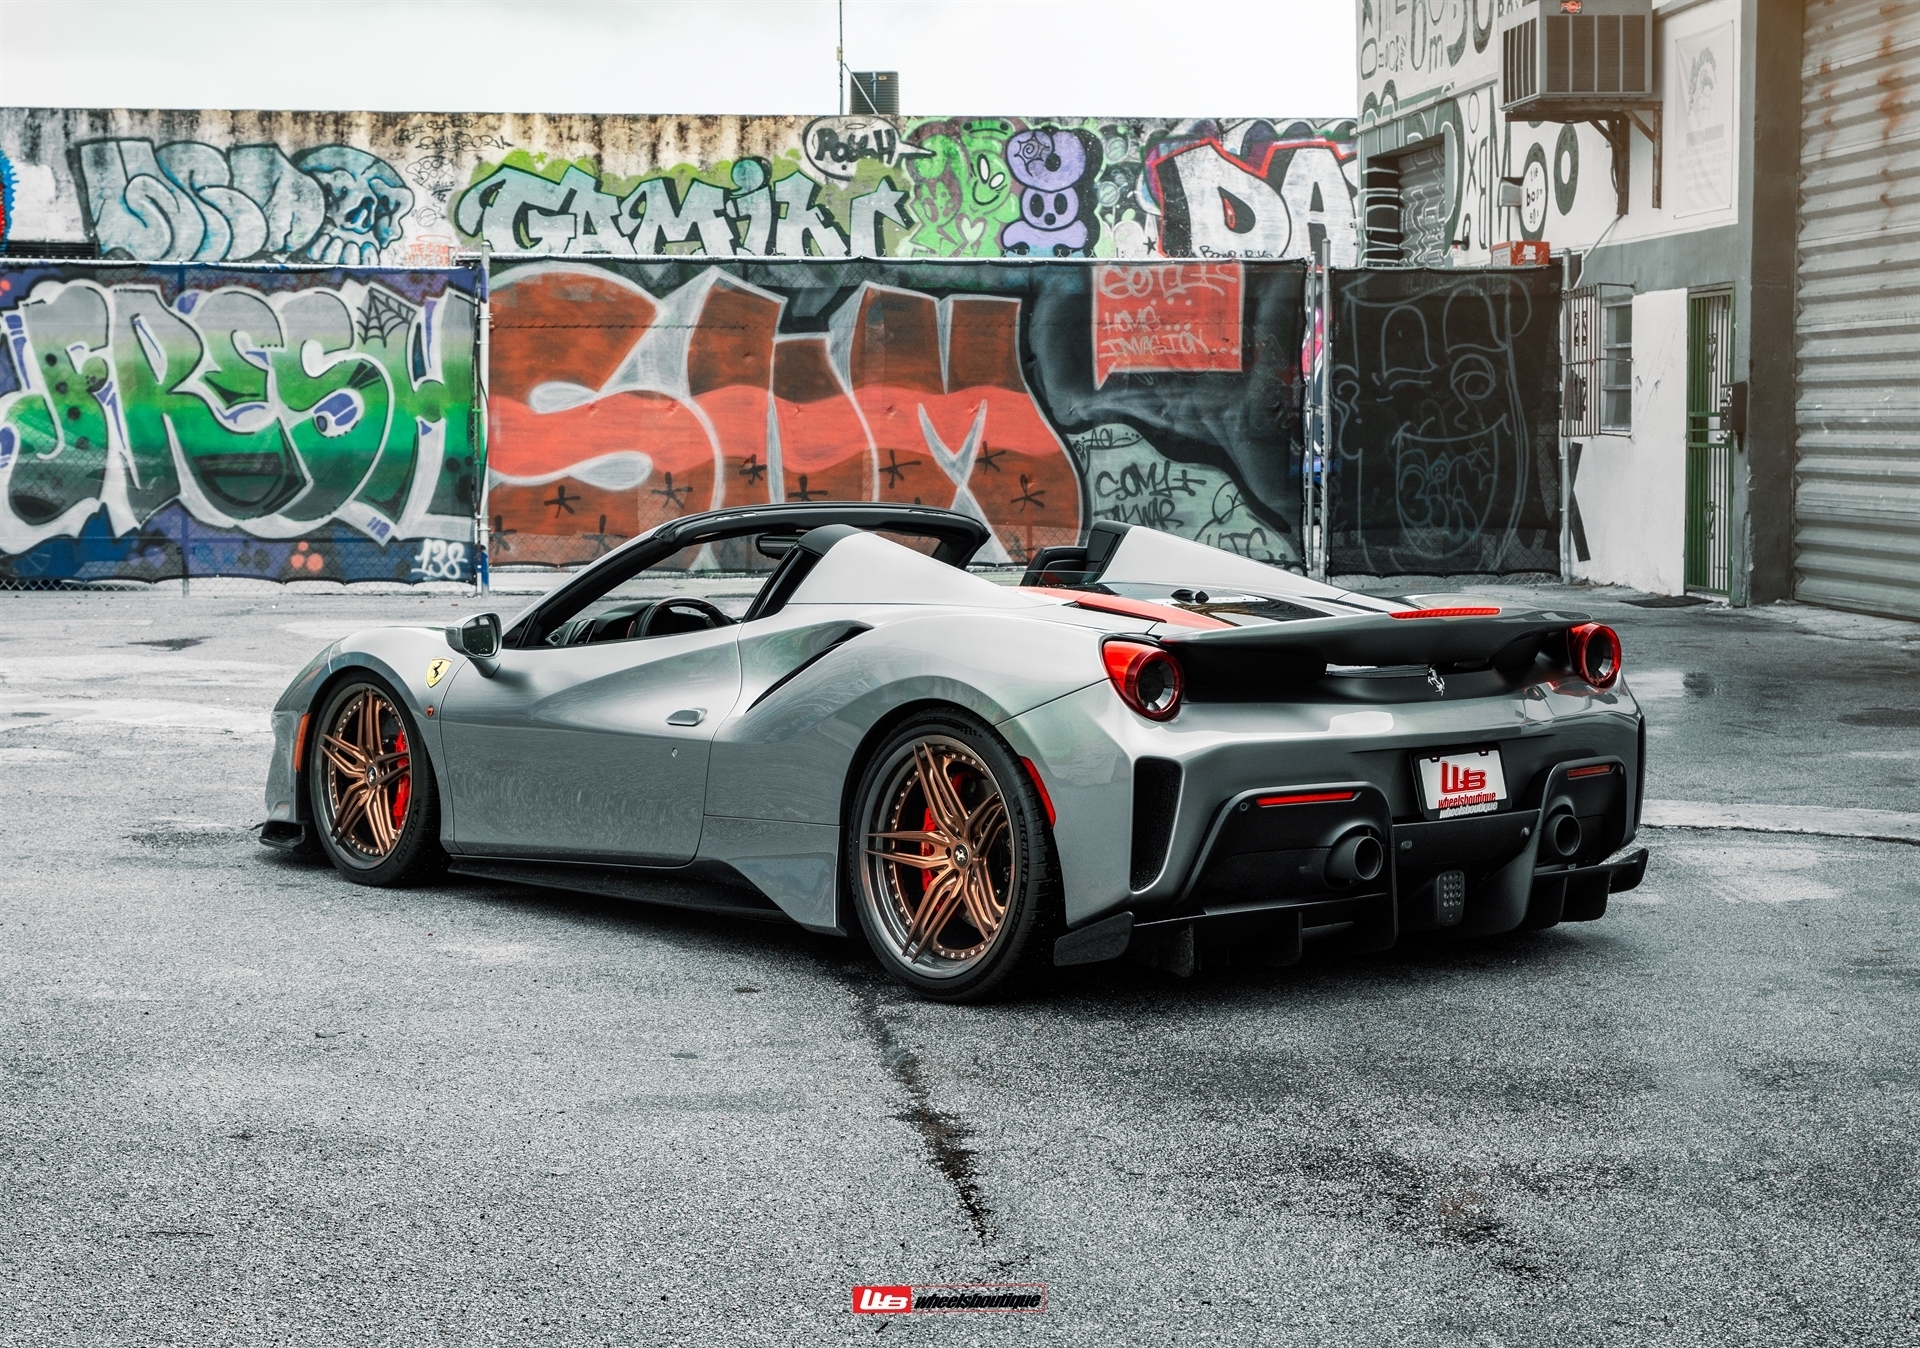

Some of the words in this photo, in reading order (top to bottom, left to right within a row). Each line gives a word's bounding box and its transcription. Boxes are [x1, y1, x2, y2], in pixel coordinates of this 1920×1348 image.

[411, 538, 468, 582] 138
[1438, 791, 1497, 810] wheelsboutique
[1439, 801, 1499, 819] wheelsboutique
[1017, 815, 1029, 883] MICHELIN
